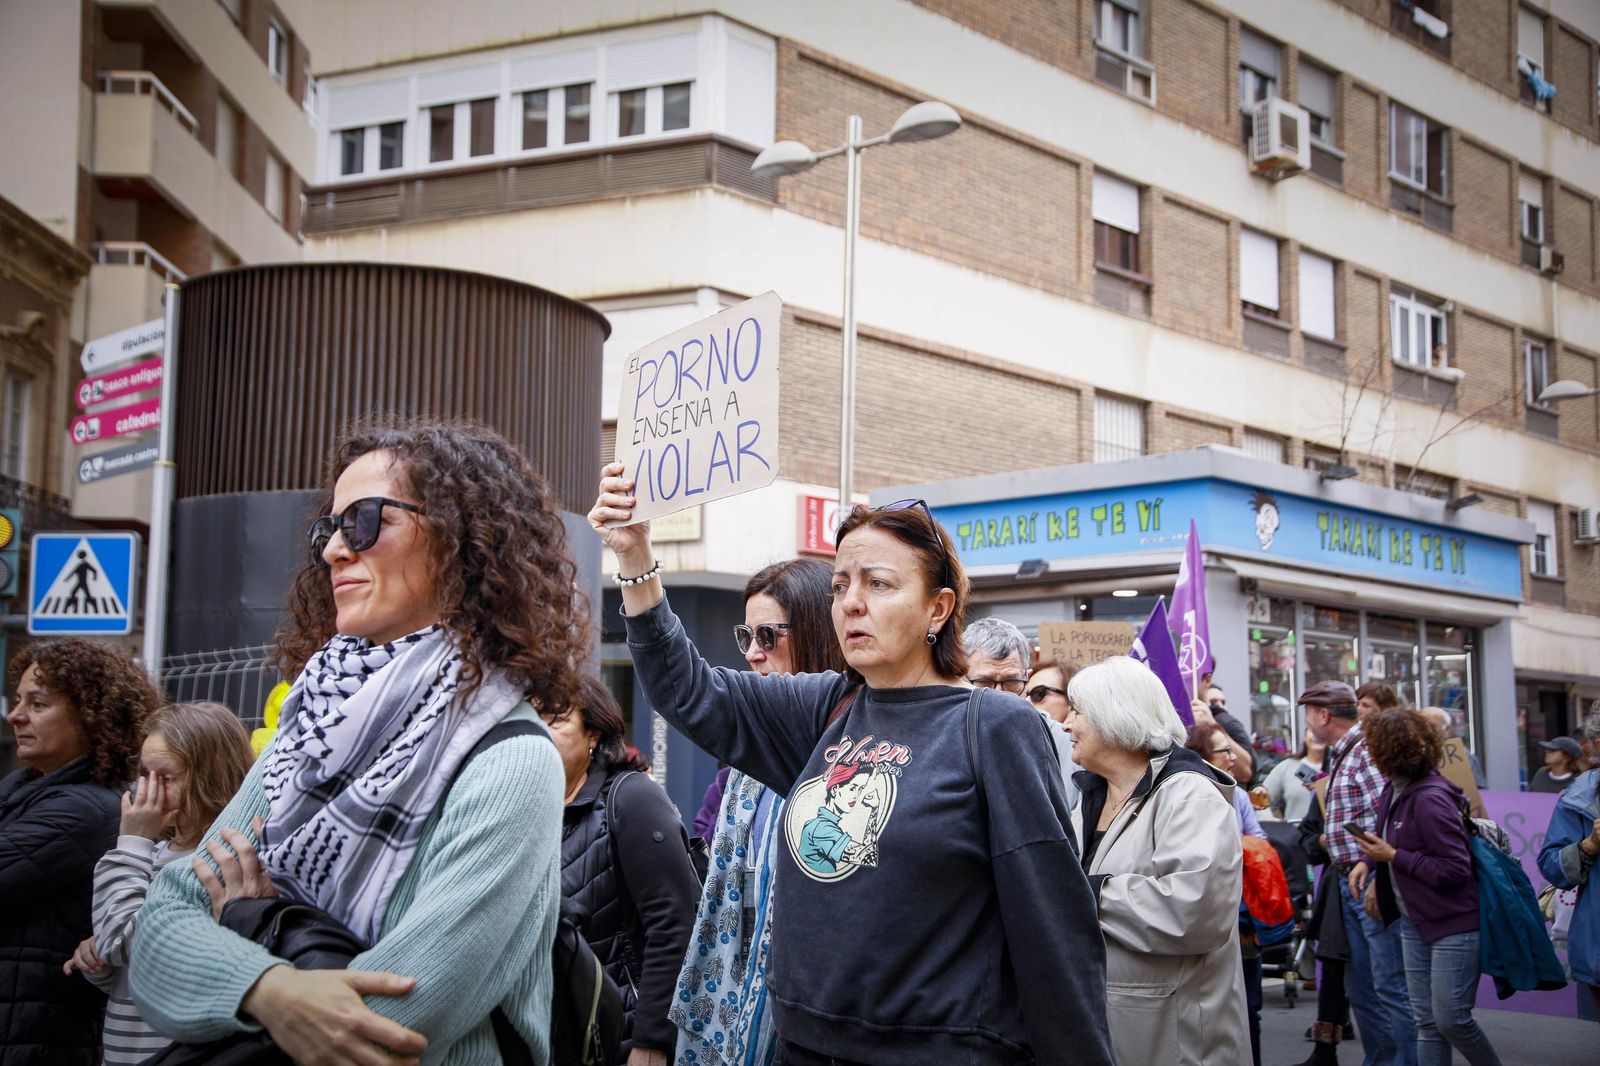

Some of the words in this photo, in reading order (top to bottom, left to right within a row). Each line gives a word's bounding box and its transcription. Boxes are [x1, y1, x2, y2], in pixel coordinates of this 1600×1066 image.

[628, 356, 640, 374] EL
[633, 317, 762, 419] PORNO
[115, 406, 160, 432] catedral
[632, 396, 713, 446] ENSEÑA
[724, 390, 740, 421] A
[619, 420, 771, 502] VIOLAR
[957, 511, 1039, 551] TARARÍ
[1047, 506, 1080, 542] KE
[1091, 501, 1126, 536] TE
[1136, 497, 1163, 532] VÍ
[1389, 527, 1413, 566] KE
[1420, 533, 1444, 571] TE
[1051, 630, 1066, 645] LA
[1052, 648, 1065, 659] ES
[1070, 648, 1084, 661] LA
